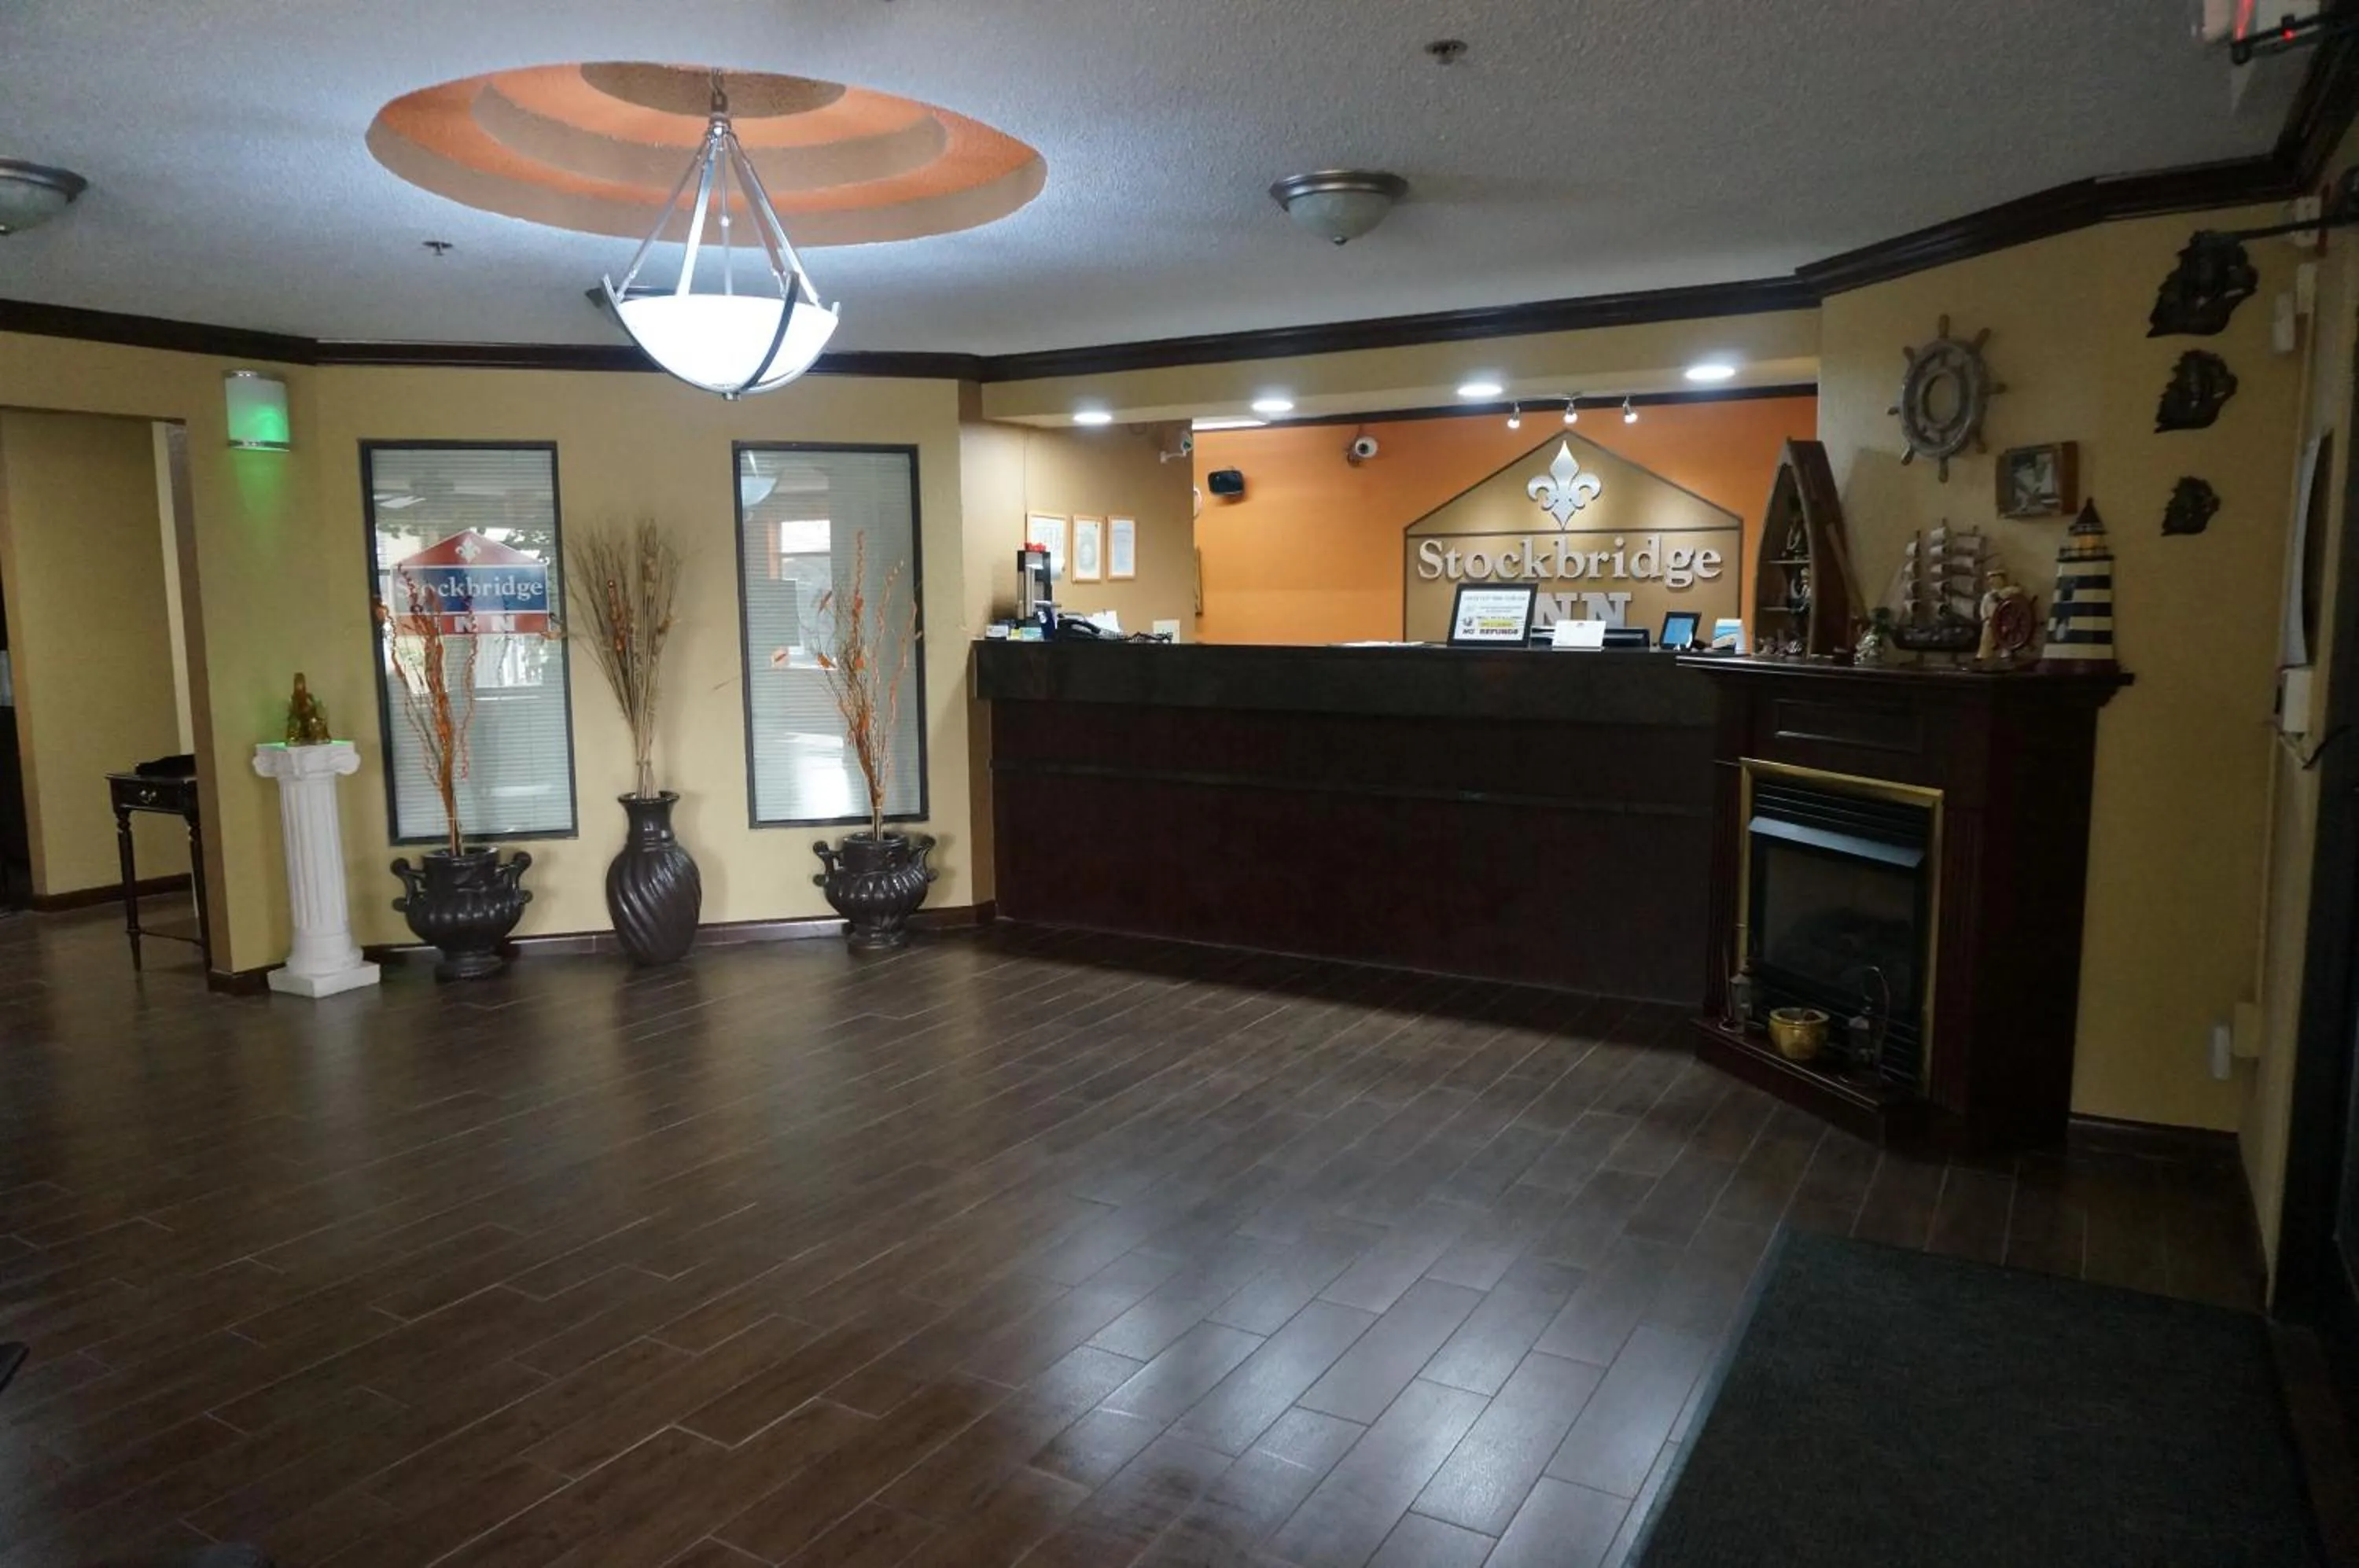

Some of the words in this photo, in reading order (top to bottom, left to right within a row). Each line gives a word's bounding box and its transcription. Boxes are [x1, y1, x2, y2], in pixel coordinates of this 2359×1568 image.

[1417, 535, 1724, 588] Stockbridge
[396, 575, 543, 601] Sockbridge
[1533, 592, 1632, 629] NN
